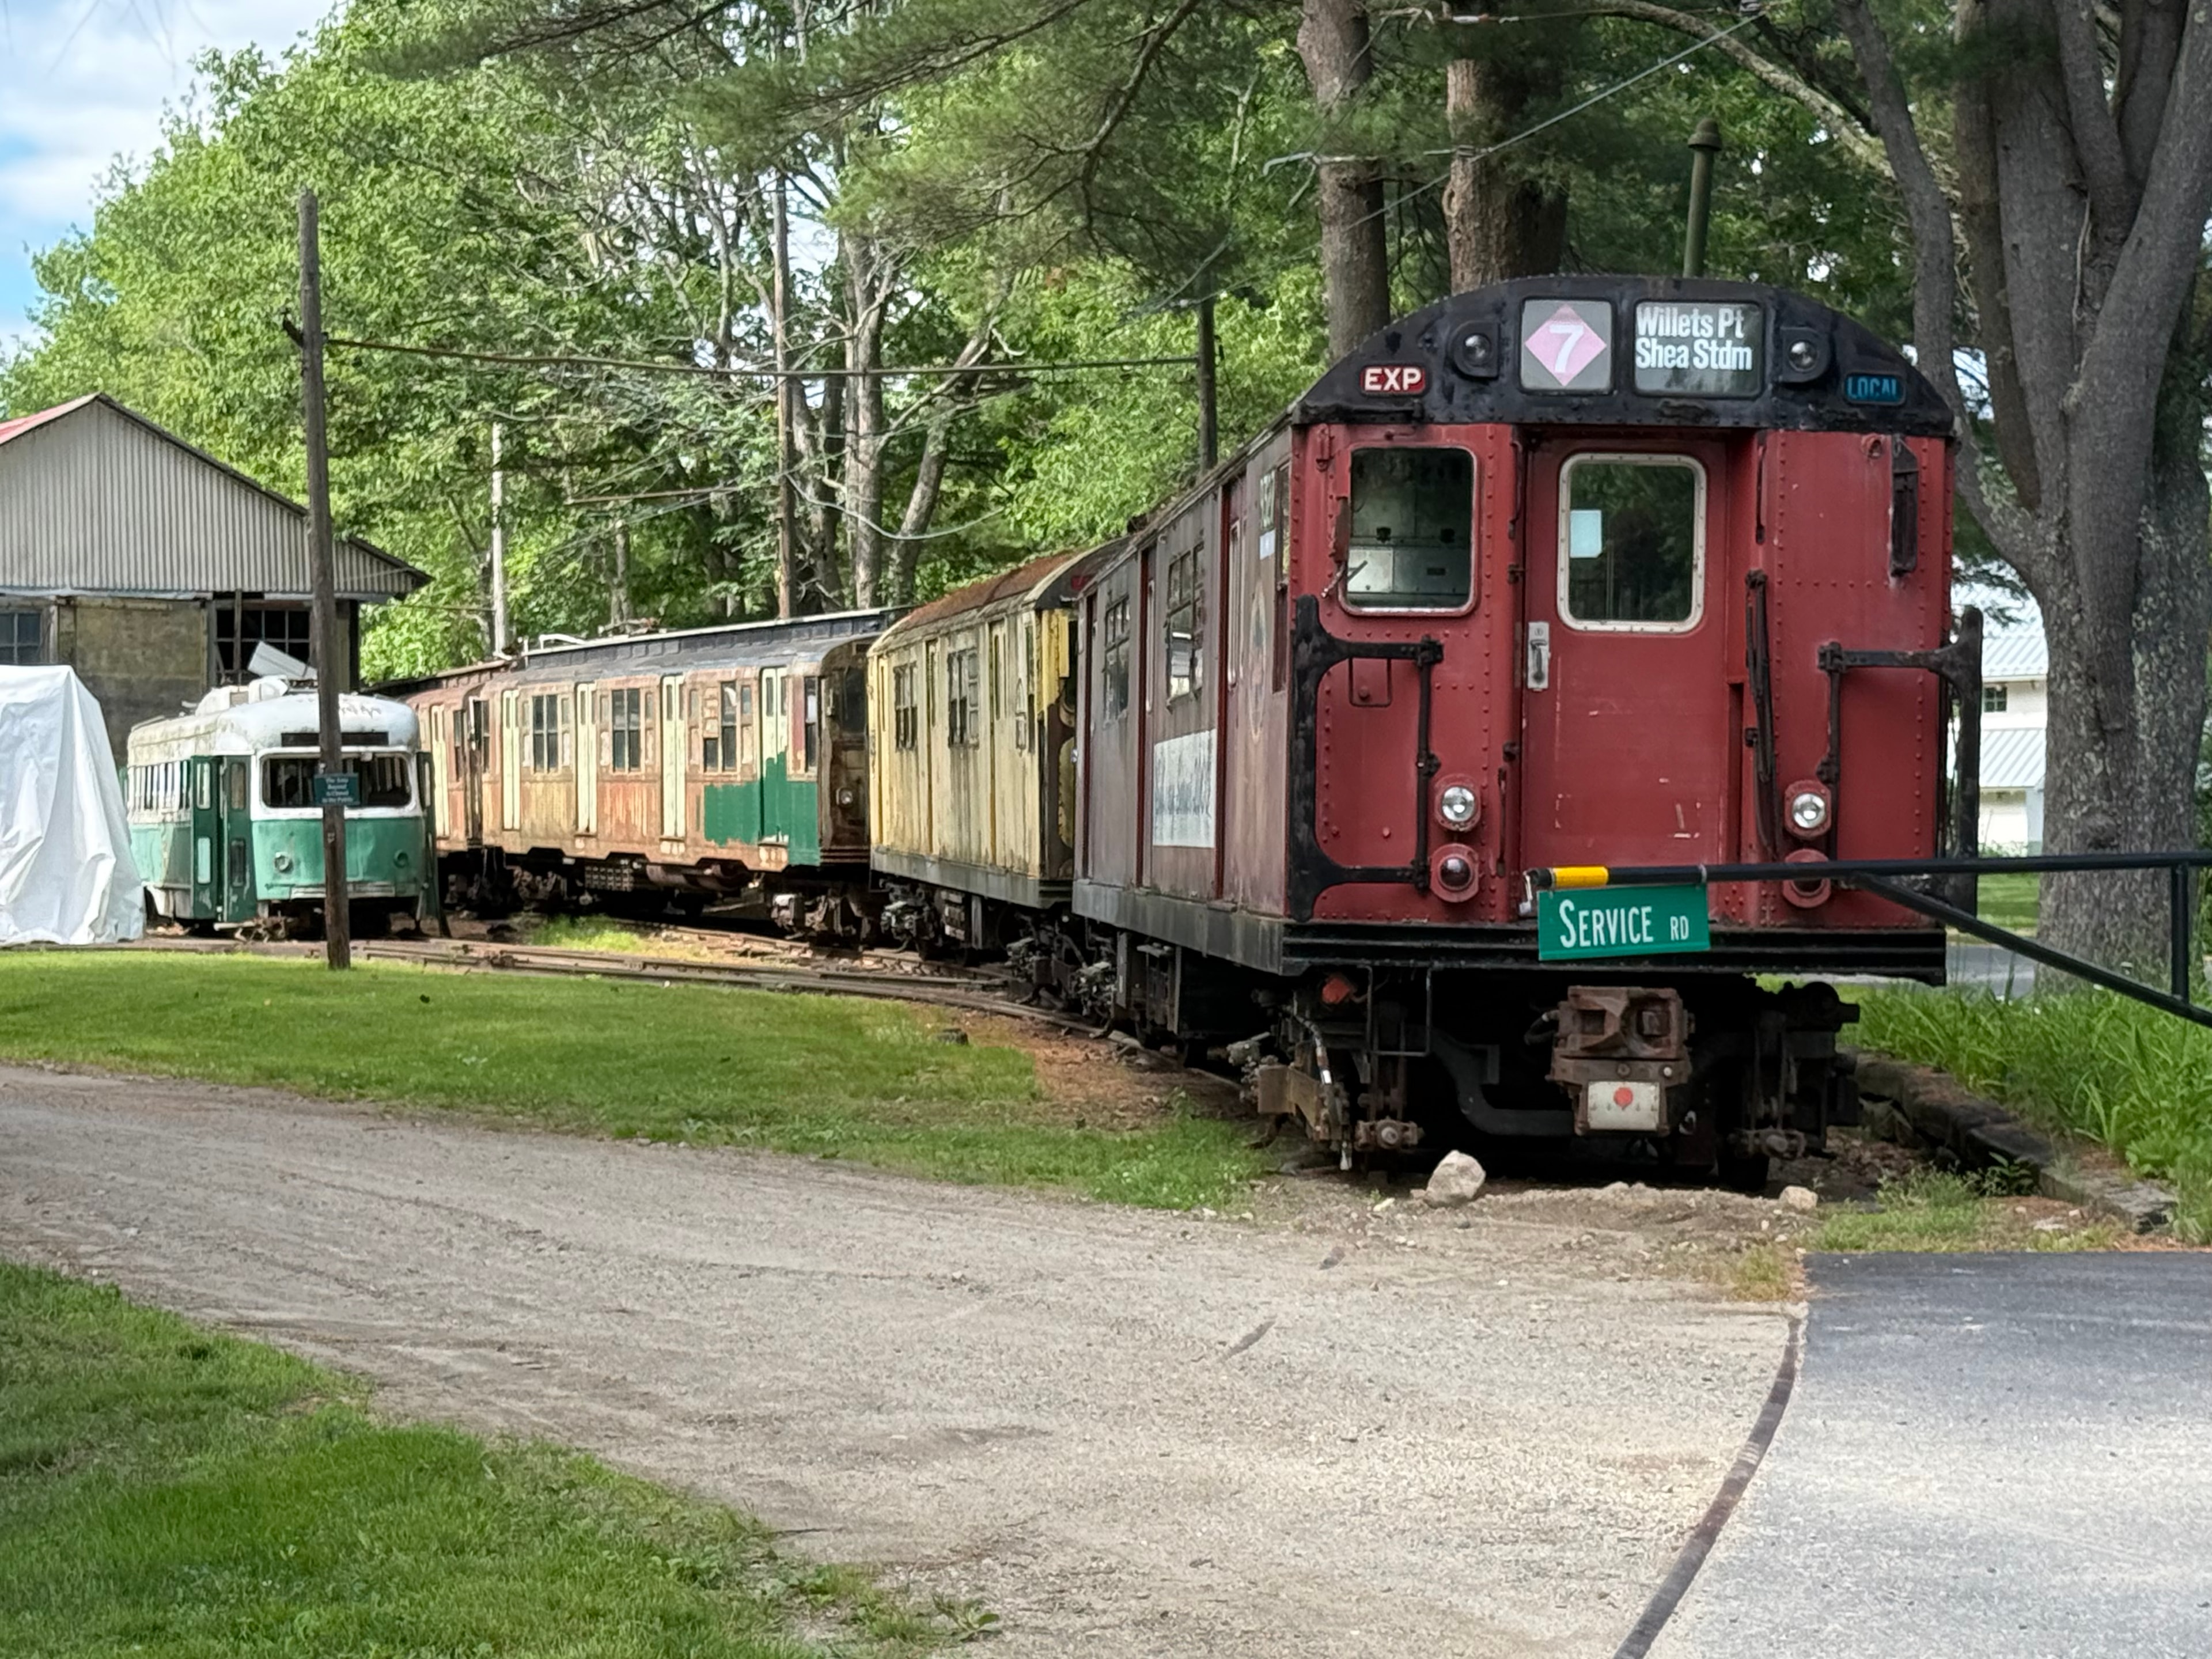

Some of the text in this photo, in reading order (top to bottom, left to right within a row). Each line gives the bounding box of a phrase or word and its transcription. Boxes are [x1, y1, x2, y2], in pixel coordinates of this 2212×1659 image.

[1636, 306, 1744, 339] Willets Pt
[1549, 324, 1584, 374] 7
[1635, 337, 1753, 370] Shea Stdm
[1364, 367, 1422, 391] EXP
[1559, 899, 1689, 948] SERVICE RD
